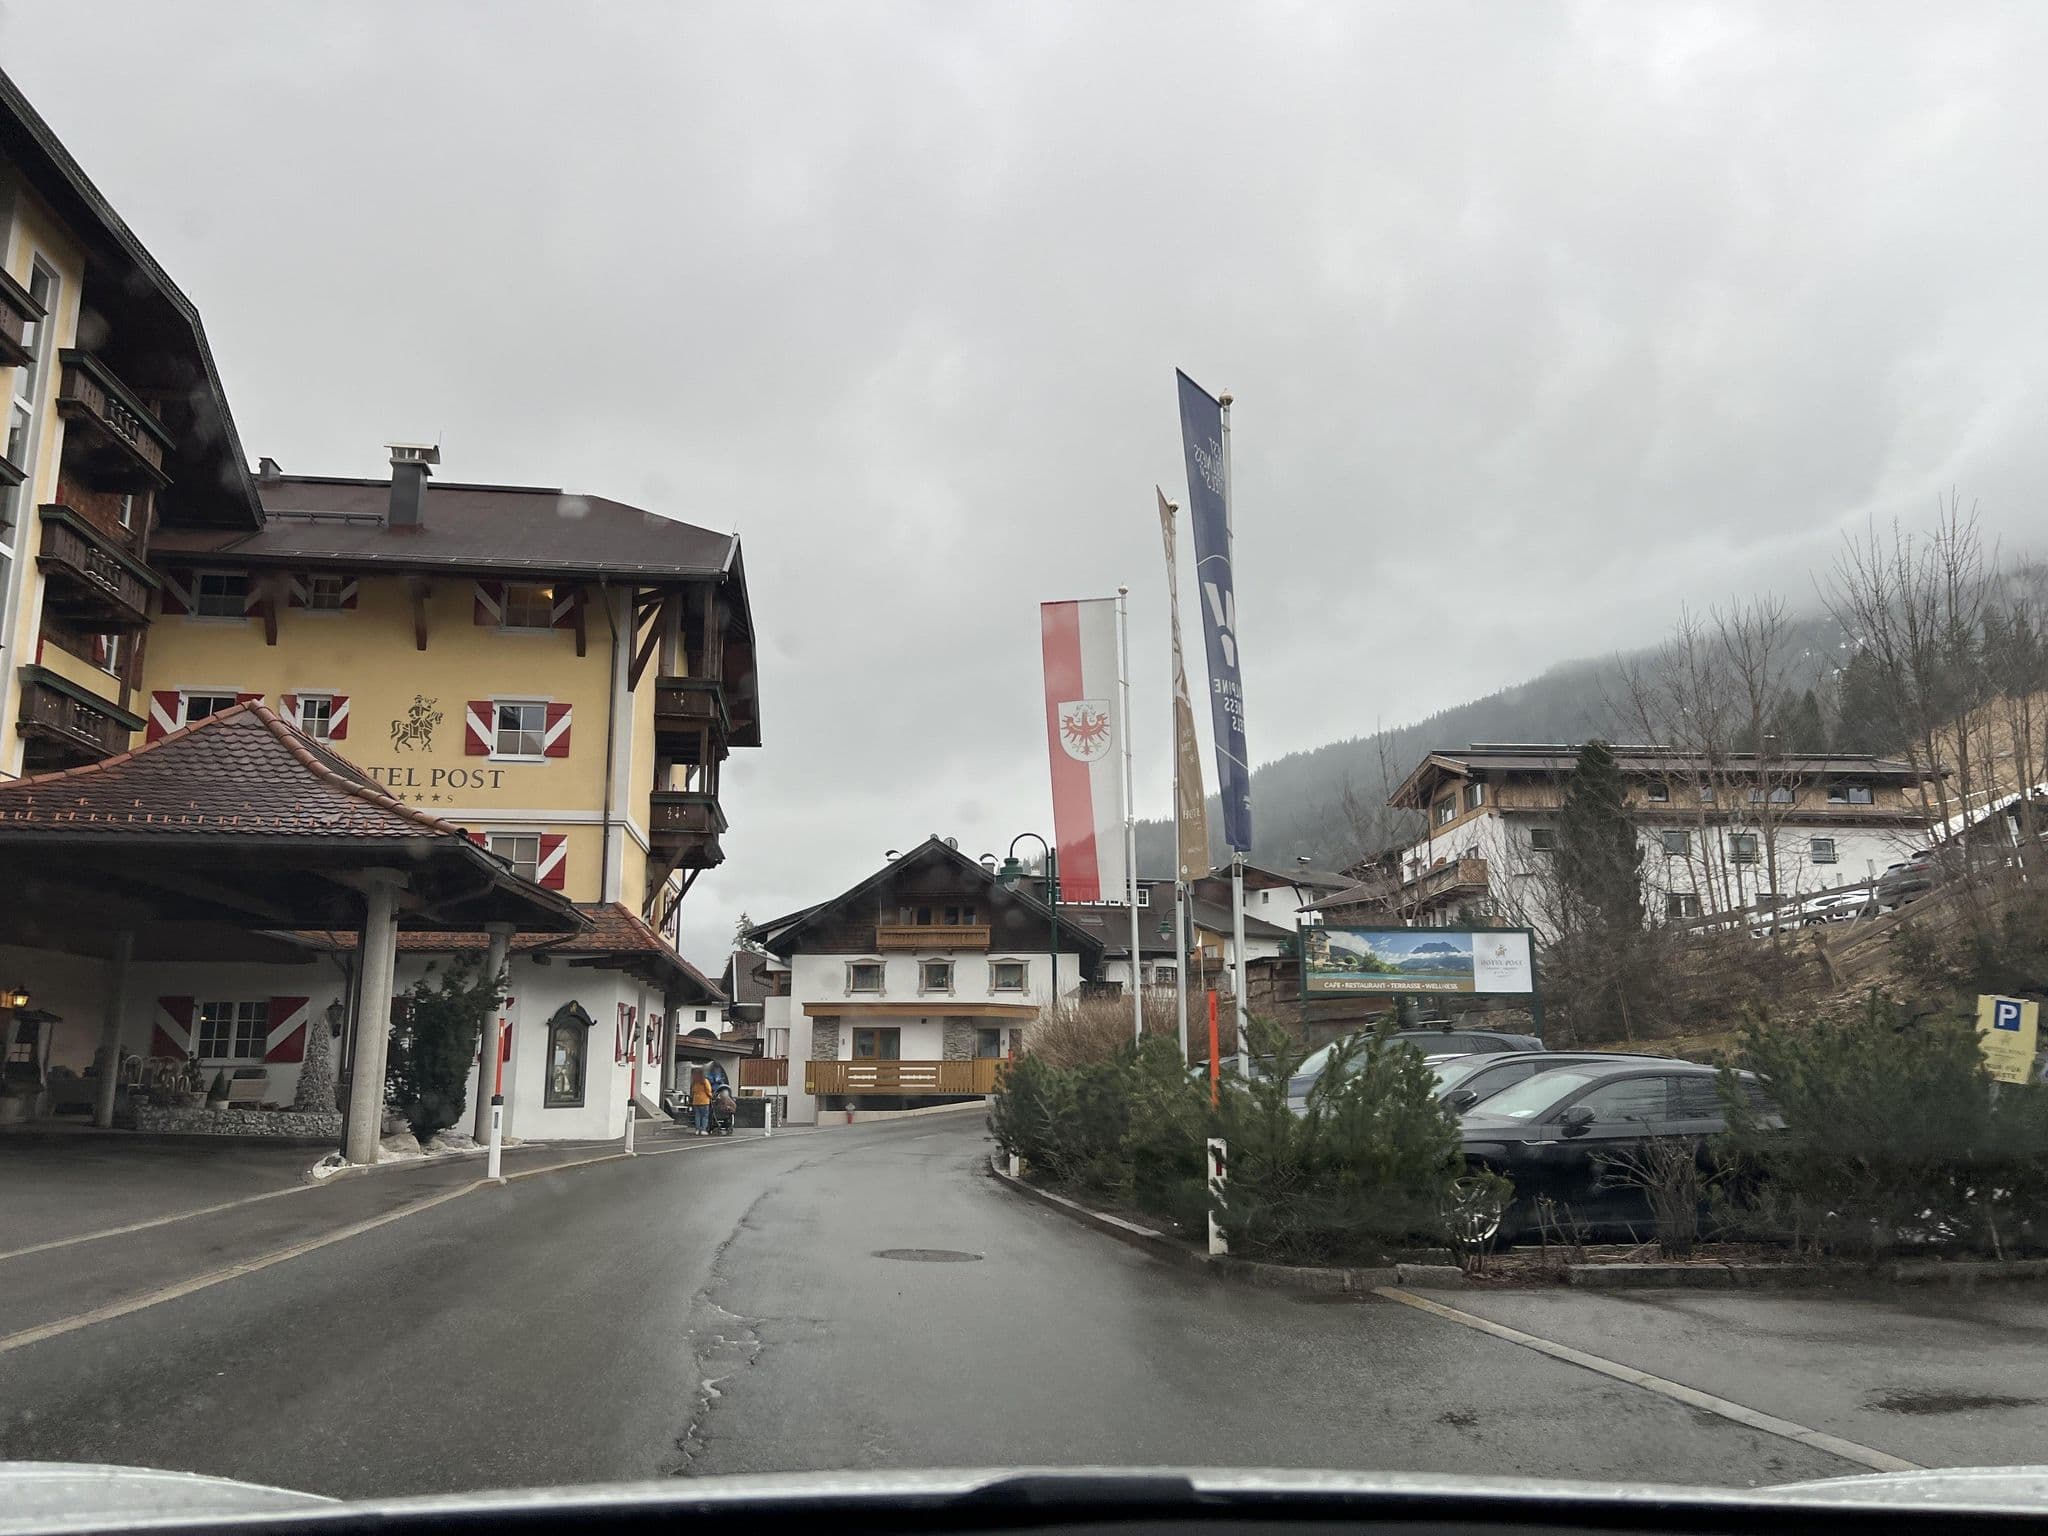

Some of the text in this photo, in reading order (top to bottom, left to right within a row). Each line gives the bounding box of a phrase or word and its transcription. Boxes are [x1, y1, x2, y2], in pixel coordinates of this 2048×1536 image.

[431, 768, 505, 789] POST
[1390, 982, 1421, 990] TERRASSE
[1424, 982, 1458, 990] WELLNESS
[1998, 1004, 2018, 1026] P
